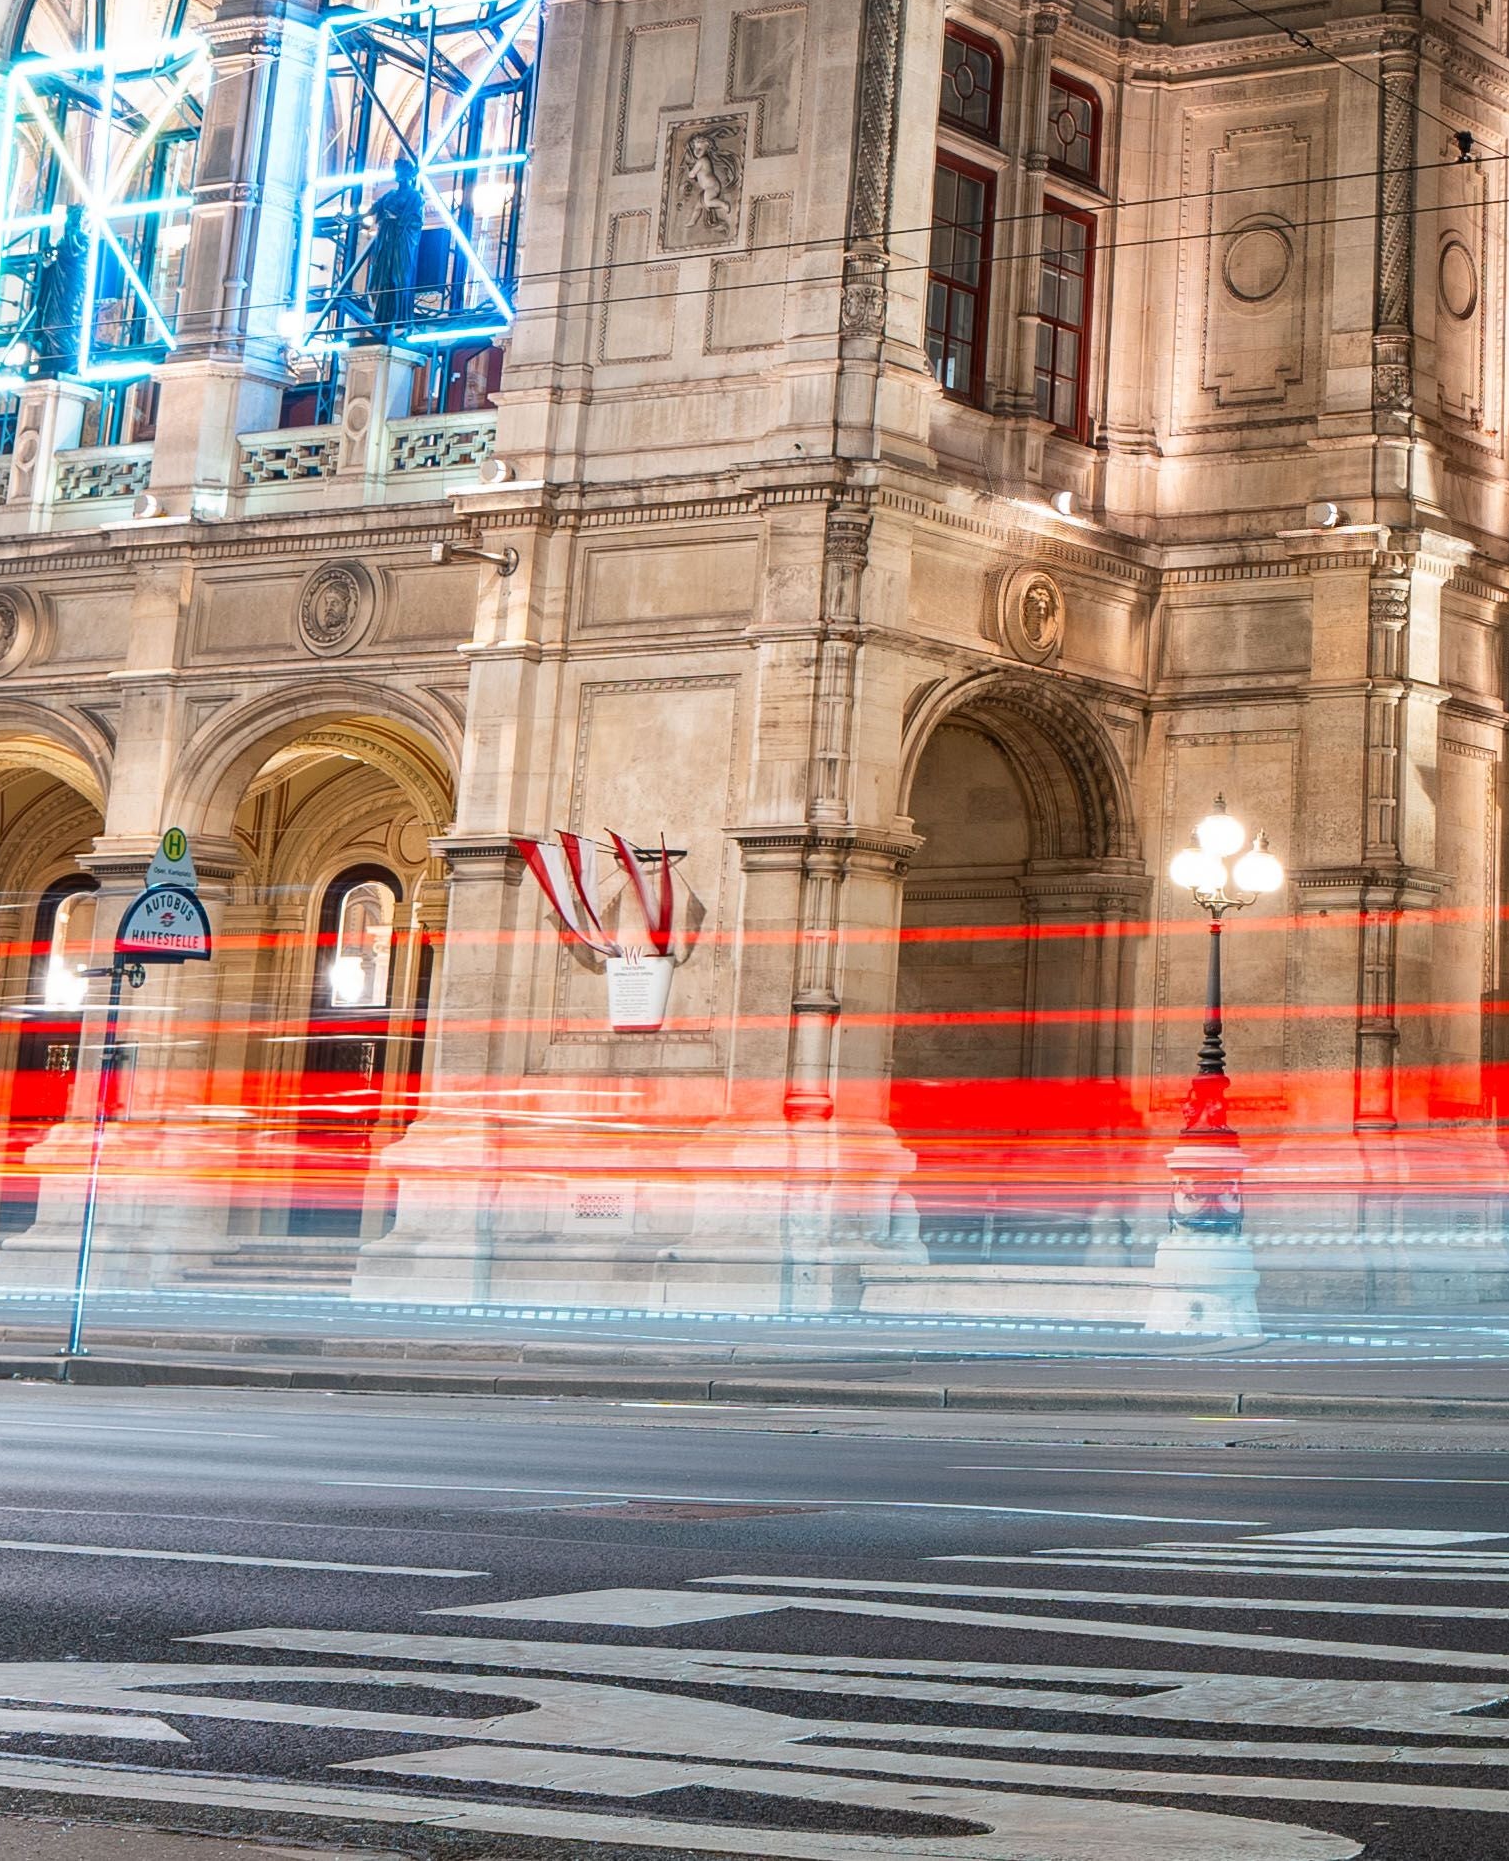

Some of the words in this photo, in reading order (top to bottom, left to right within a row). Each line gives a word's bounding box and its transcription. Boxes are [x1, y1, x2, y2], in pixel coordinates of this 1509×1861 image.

[169, 835, 180, 856] H
[145, 894, 194, 922] AUTOBUS
[132, 929, 199, 949] HALTESTELLE
